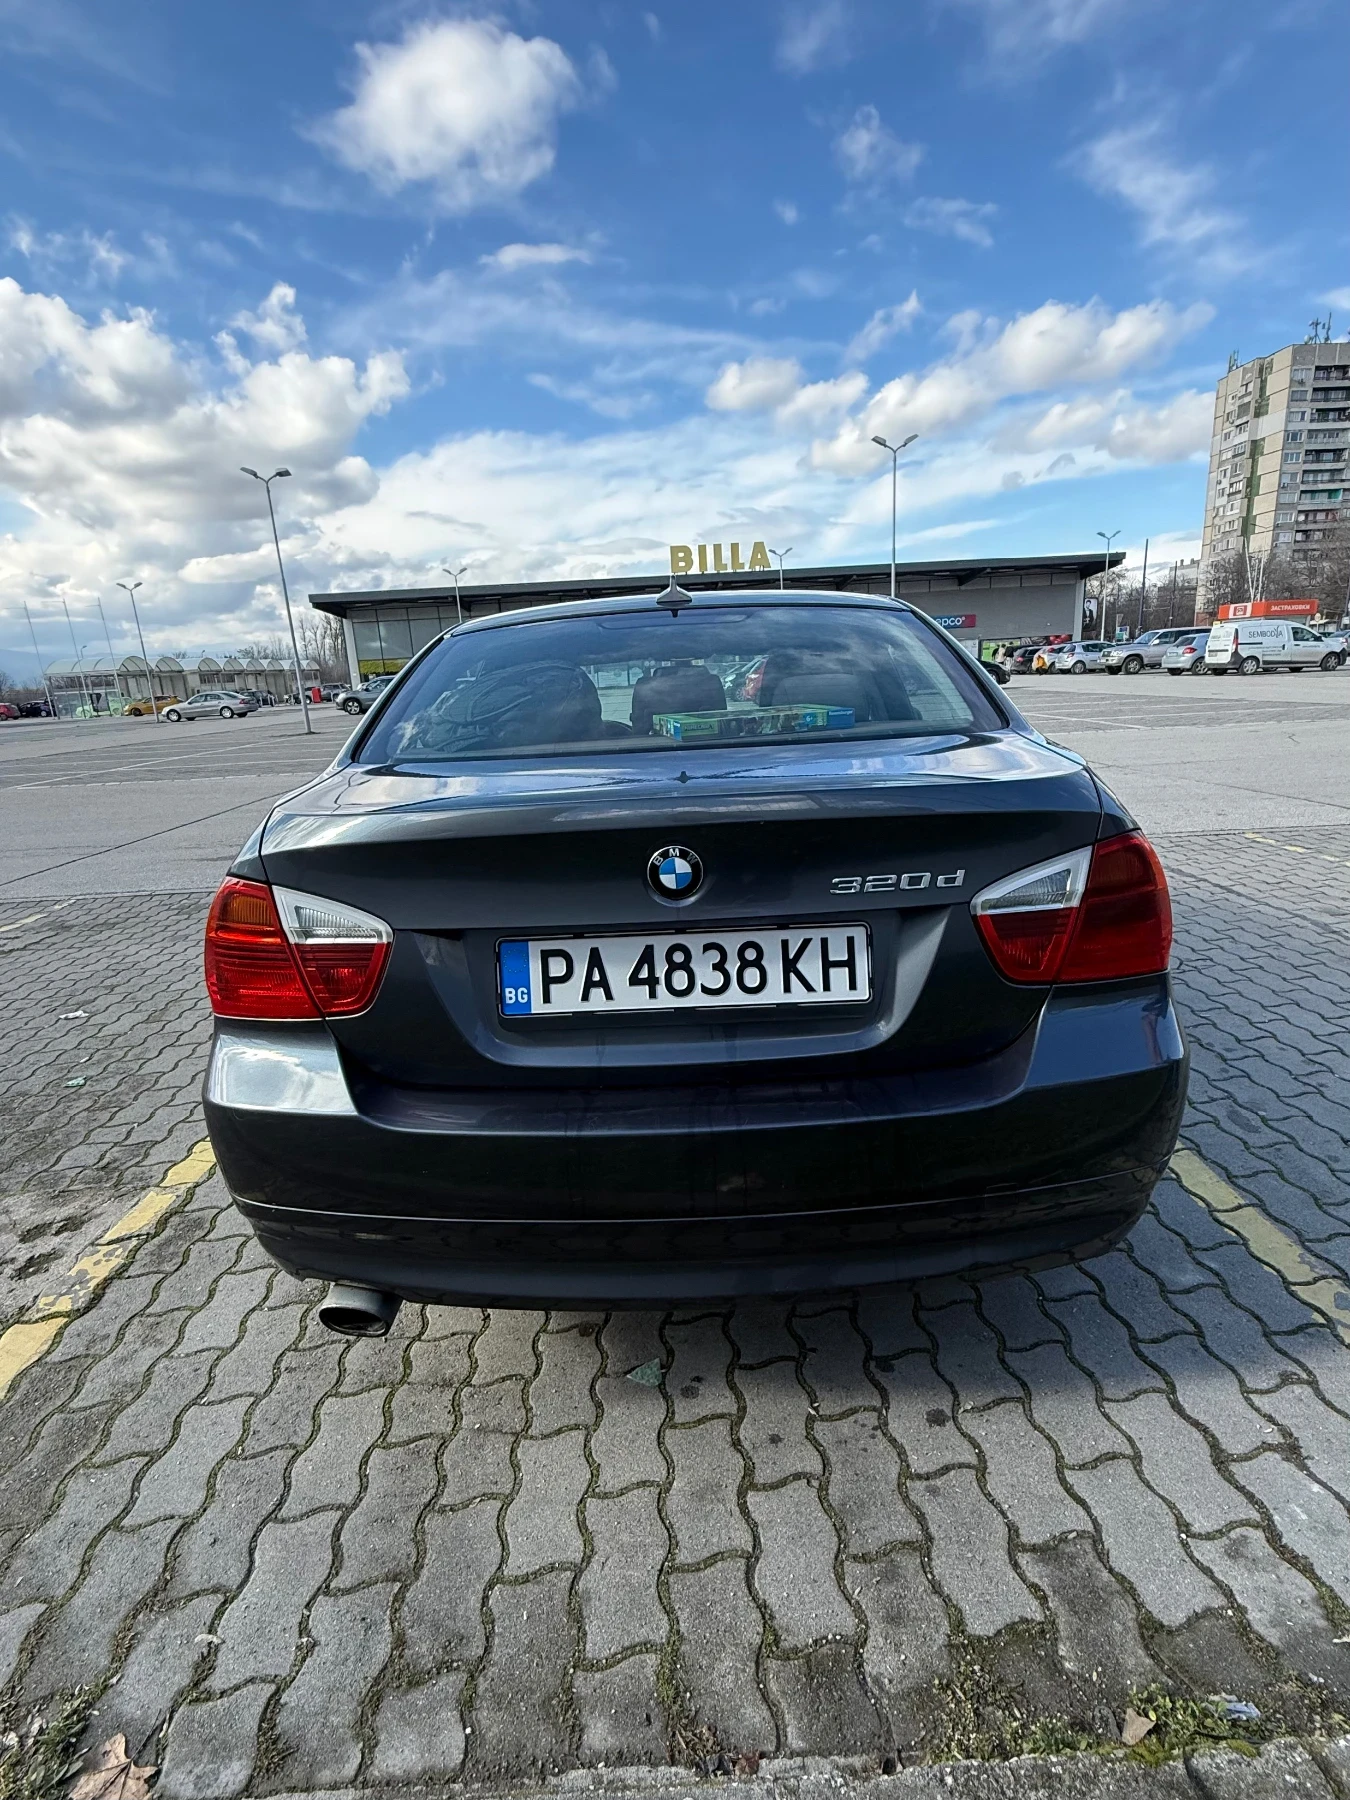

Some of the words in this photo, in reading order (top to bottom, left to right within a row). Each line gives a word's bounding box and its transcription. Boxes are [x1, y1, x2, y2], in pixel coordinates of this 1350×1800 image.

[669, 541, 771, 573] BILLA
[935, 617, 963, 627] epco
[652, 848, 698, 866] BMW
[830, 869, 966, 894] 320d
[540, 946, 614, 1004] PA
[628, 940, 767, 999] 4838
[780, 936, 857, 994] KH
[505, 988, 528, 1004] BG
